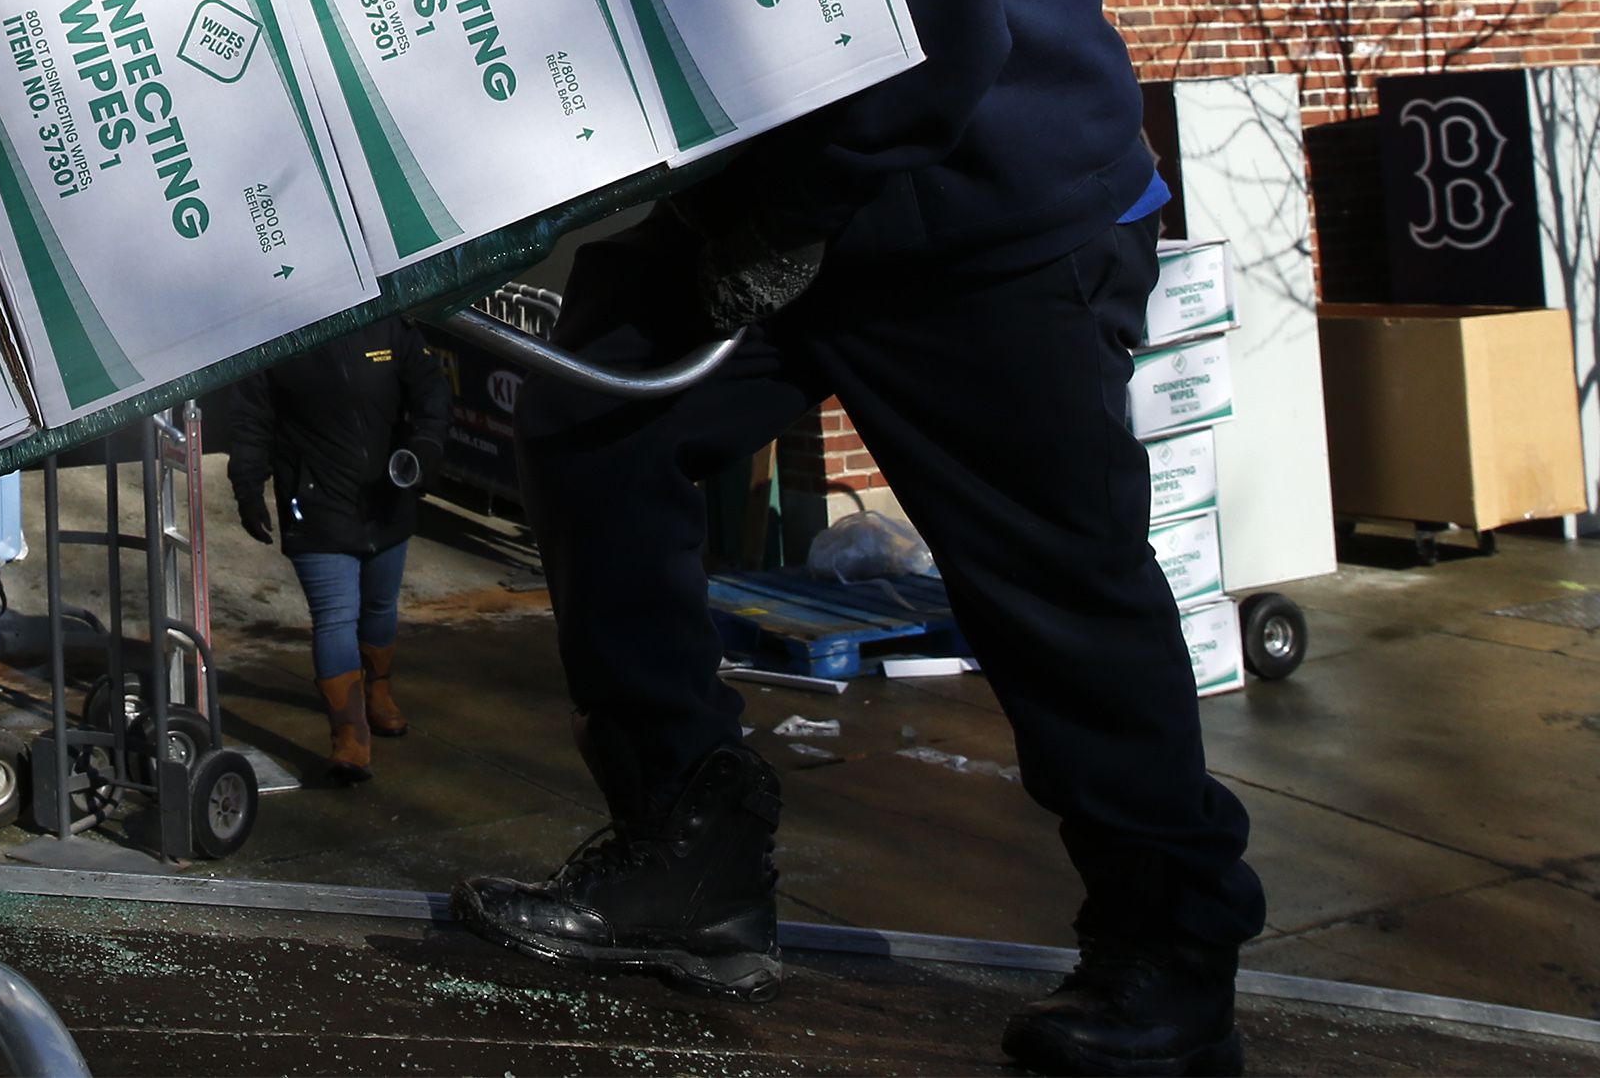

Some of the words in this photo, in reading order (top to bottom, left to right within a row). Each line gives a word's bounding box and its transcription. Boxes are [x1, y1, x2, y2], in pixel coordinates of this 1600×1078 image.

[26, 10, 43, 36] 800
[202, 17, 245, 49] WIPES
[831, 3, 844, 18] CT
[36, 39, 50, 54] CT
[3, 15, 38, 72] ITEM
[23, 76, 49, 119] NO.
[39, 124, 79, 198] 37301
[41, 58, 78, 143] DISINFECTING
[546, 54, 563, 88] REFILL
[558, 88, 573, 116] BAGS
[557, 51, 578, 92] 4/800
[572, 95, 586, 110] CT
[1400, 96, 1513, 250] B
[244, 187, 261, 223] REFILL
[255, 223, 272, 253] BAGS
[257, 184, 278, 227] 4/800
[271, 230, 286, 246] CT
[1165, 279, 1214, 298] DISINFECTING
[1153, 374, 1211, 394] DISINFECTING
